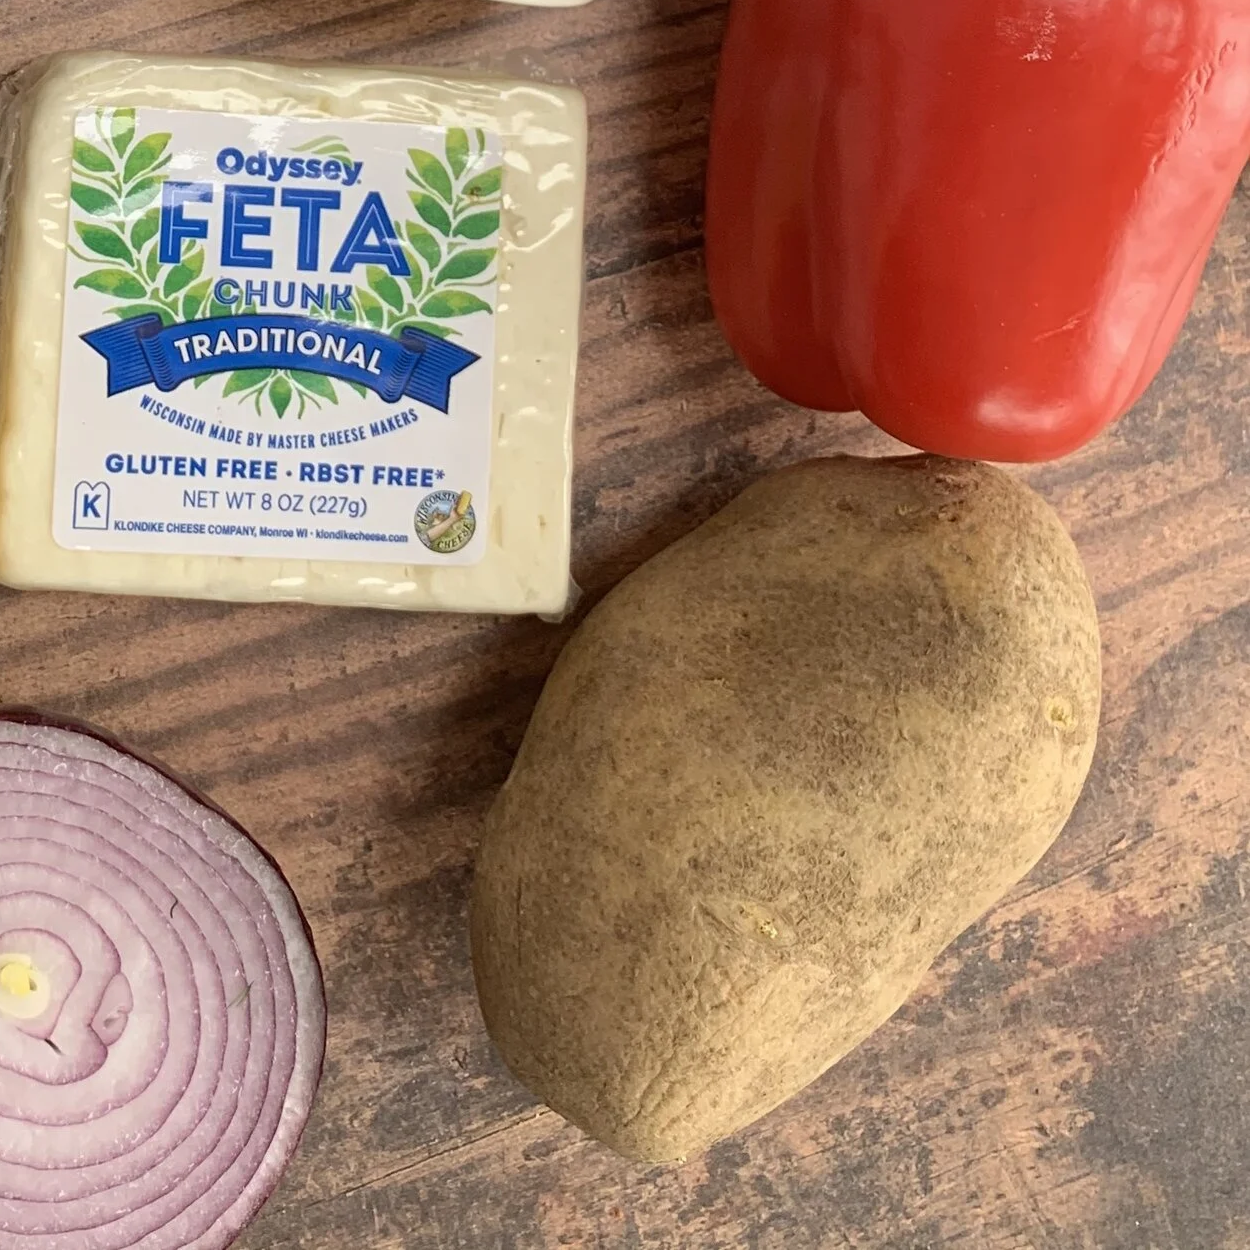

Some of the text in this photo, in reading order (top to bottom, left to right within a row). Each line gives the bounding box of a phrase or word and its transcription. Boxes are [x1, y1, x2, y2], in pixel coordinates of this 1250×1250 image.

[216, 147, 364, 186] Odyssey
[158, 181, 411, 277] FETA
[214, 278, 354, 311] CHUNK
[174, 328, 382, 376] TRADITIONAL
[139, 394, 419, 450] WISCONSIN MADE BY MASTER CHEESE MAKERS
[105, 453, 207, 478] GLUTEN
[216, 458, 278, 481] FREE
[299, 462, 365, 485] RBST
[83, 493, 101, 518] K
[182, 490, 368, 518] NET WT 8 OZ (227g)
[114, 519, 409, 544] KLONDIKE CHEESE COMPANY, Monroe WI klondikecheese.com
[437, 521, 473, 549] CHEESE
